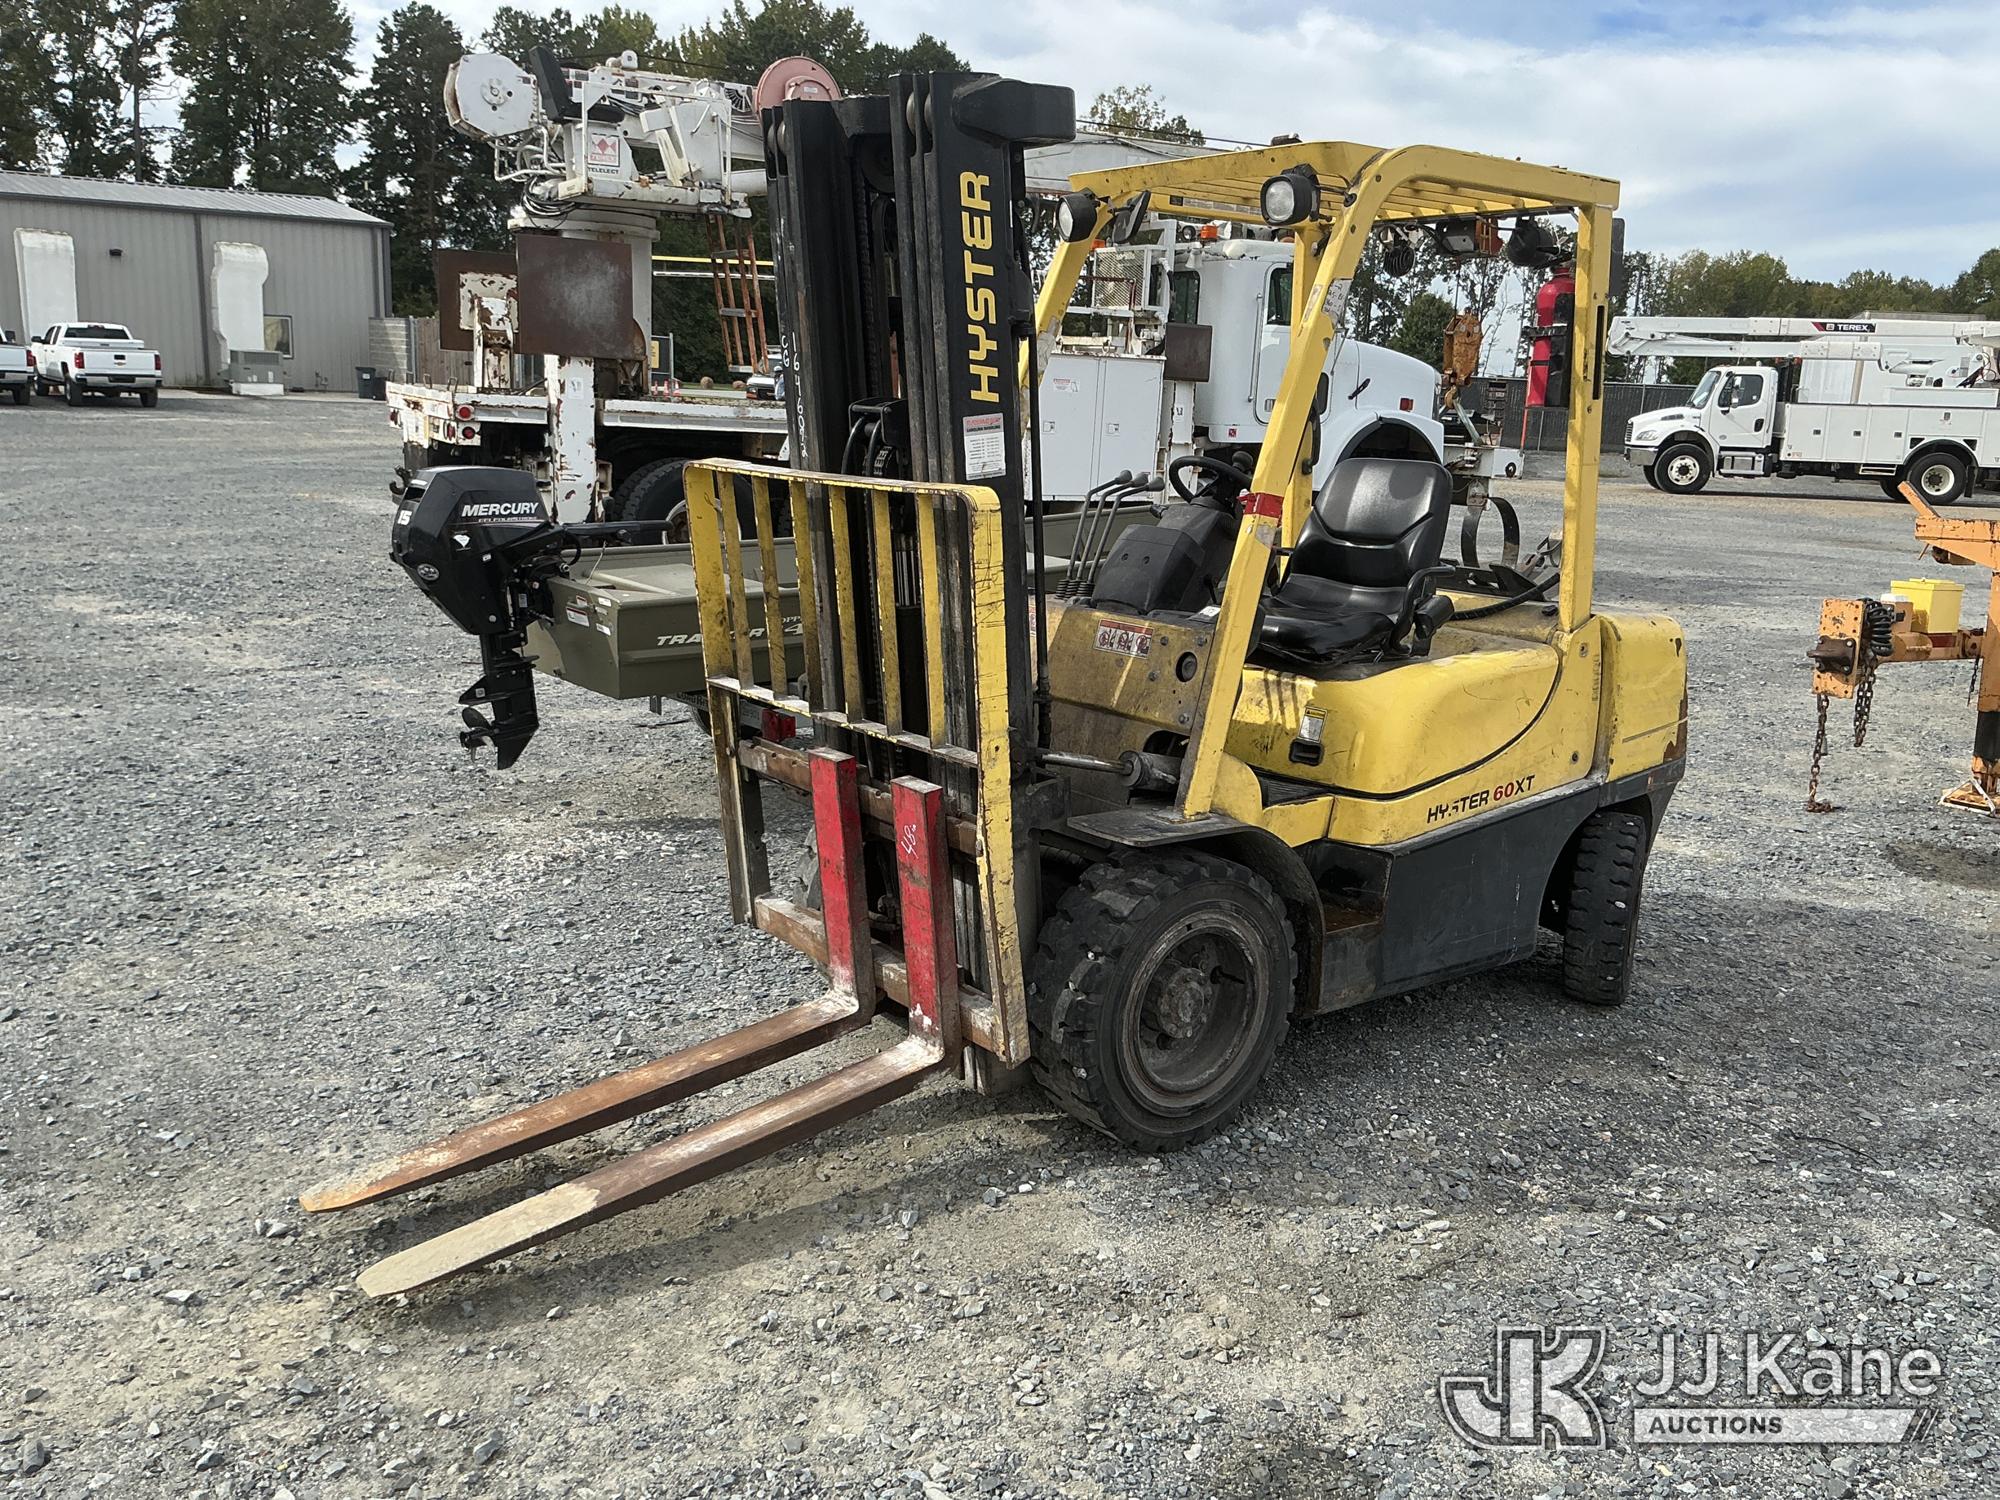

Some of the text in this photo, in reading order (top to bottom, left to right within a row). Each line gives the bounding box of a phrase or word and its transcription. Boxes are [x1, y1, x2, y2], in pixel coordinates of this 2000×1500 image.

[959, 170, 1000, 404] HYSTER
[1836, 322, 1869, 332] TEREX
[397, 509, 413, 526] 15
[461, 501, 540, 518] MERCURY
[1493, 774, 1536, 801] 60XT
